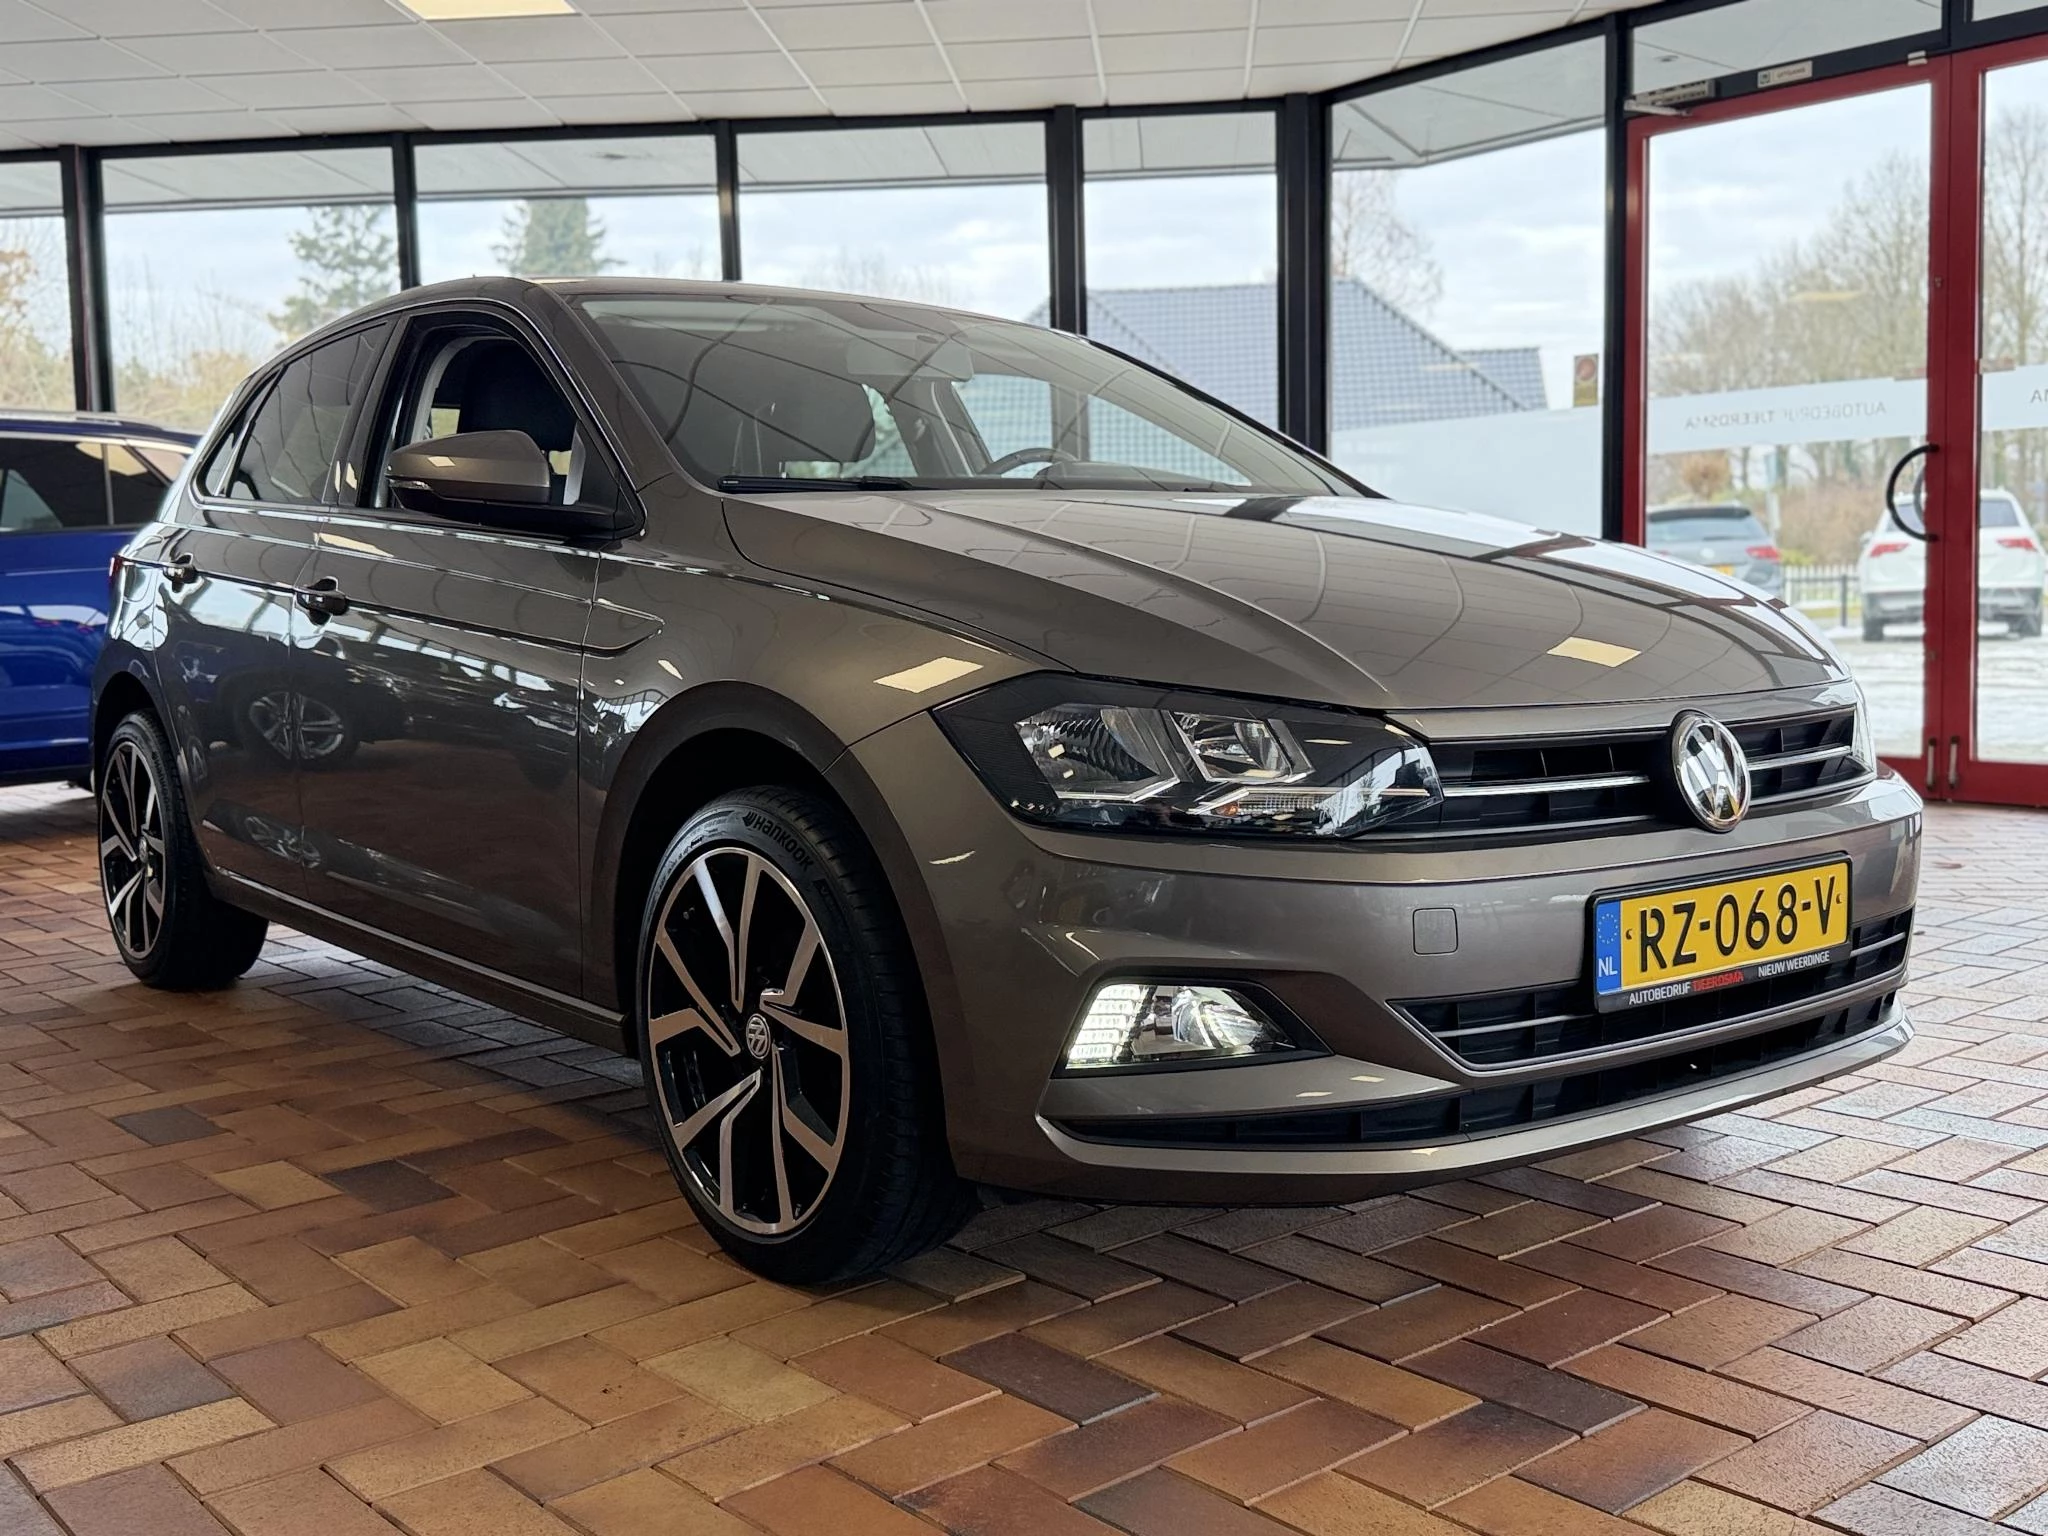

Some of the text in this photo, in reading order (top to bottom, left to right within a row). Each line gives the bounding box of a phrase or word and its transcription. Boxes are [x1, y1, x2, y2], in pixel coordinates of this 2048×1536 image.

[1639, 875, 1836, 973] RZ-068-V
[1597, 957, 1619, 979] NL
[1628, 981, 1692, 1006] AUTOBEDRIJF
[1757, 960, 1786, 978] NIEUW
[1785, 950, 1830, 972] WEERDINGE
